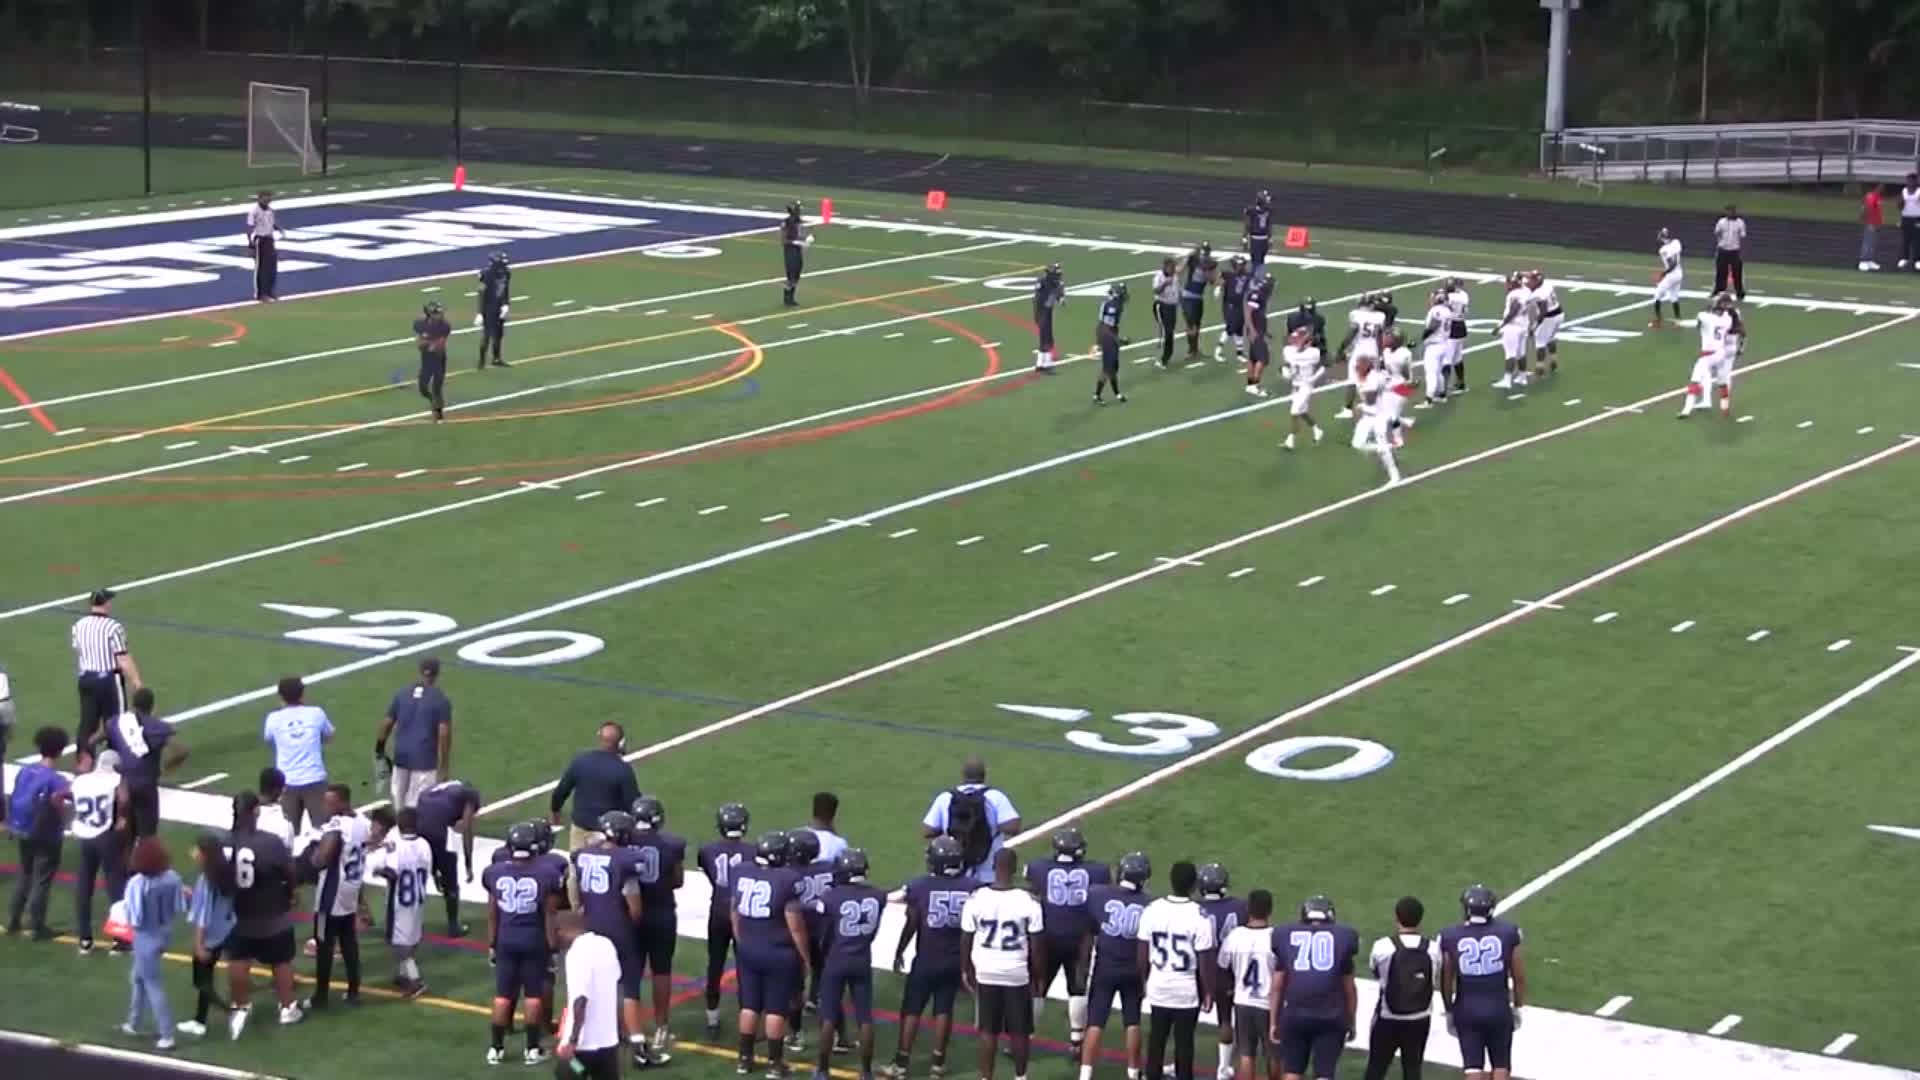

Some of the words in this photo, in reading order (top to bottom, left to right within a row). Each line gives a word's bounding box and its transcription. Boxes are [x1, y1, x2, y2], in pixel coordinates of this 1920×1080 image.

[577, 853, 612, 894] 75
[1047, 868, 1089, 905] 62
[496, 876, 538, 914] 32
[737, 876, 771, 918] 72
[927, 890, 969, 928] 55
[839, 897, 879, 937] 23
[979, 919, 1022, 950] 72
[1101, 899, 1143, 938] 30
[1152, 931, 1190, 972] 55
[1291, 931, 1334, 971] 70
[1458, 935, 1503, 976] 22
[1243, 958, 1262, 1001] 4
